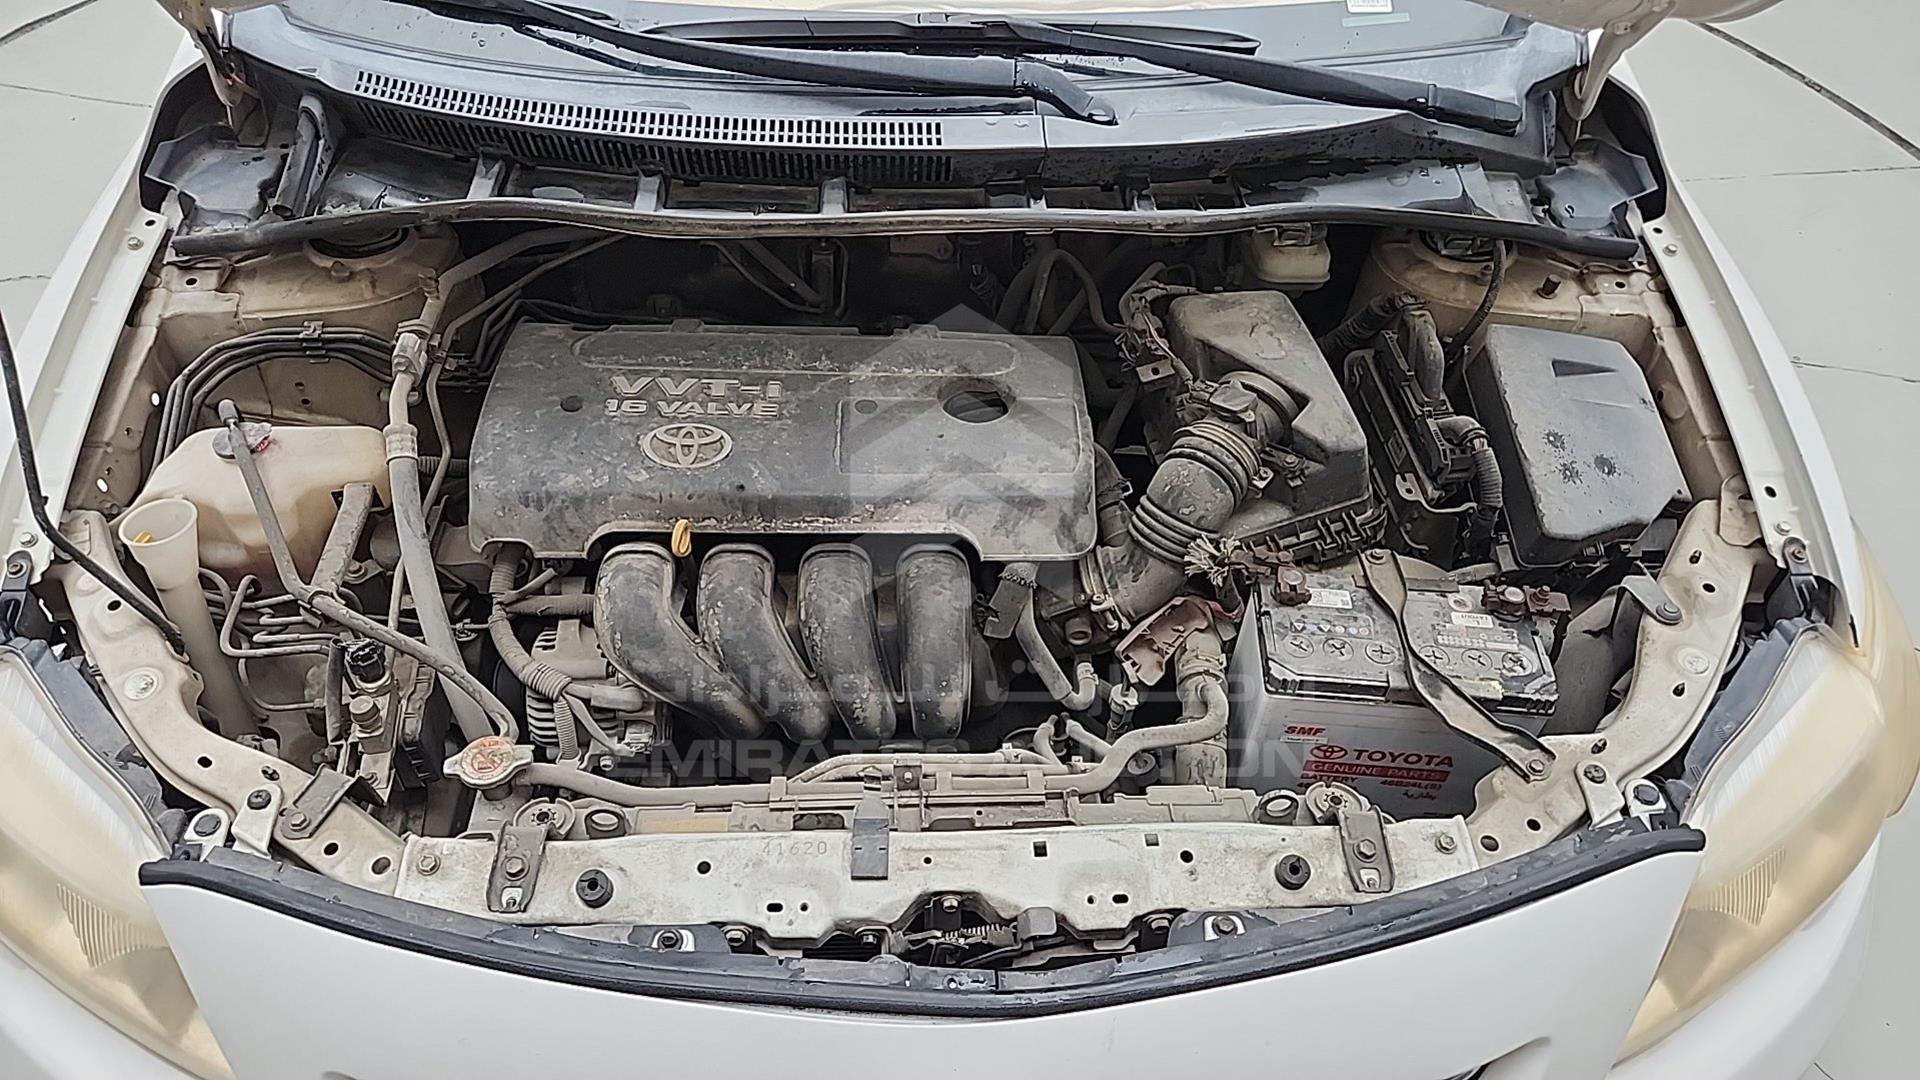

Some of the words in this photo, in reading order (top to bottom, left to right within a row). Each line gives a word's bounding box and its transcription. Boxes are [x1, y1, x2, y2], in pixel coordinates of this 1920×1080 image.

[605, 399, 648, 416] 16
[657, 400, 780, 418] VALVE
[1284, 725, 1326, 736] SMF
[1353, 748, 1454, 768] TOYOTA
[1300, 772, 1359, 783] BATTERY
[1311, 762, 1383, 776] GENUINE
[1387, 769, 1446, 781] PARTS
[762, 841, 828, 856] 41620
